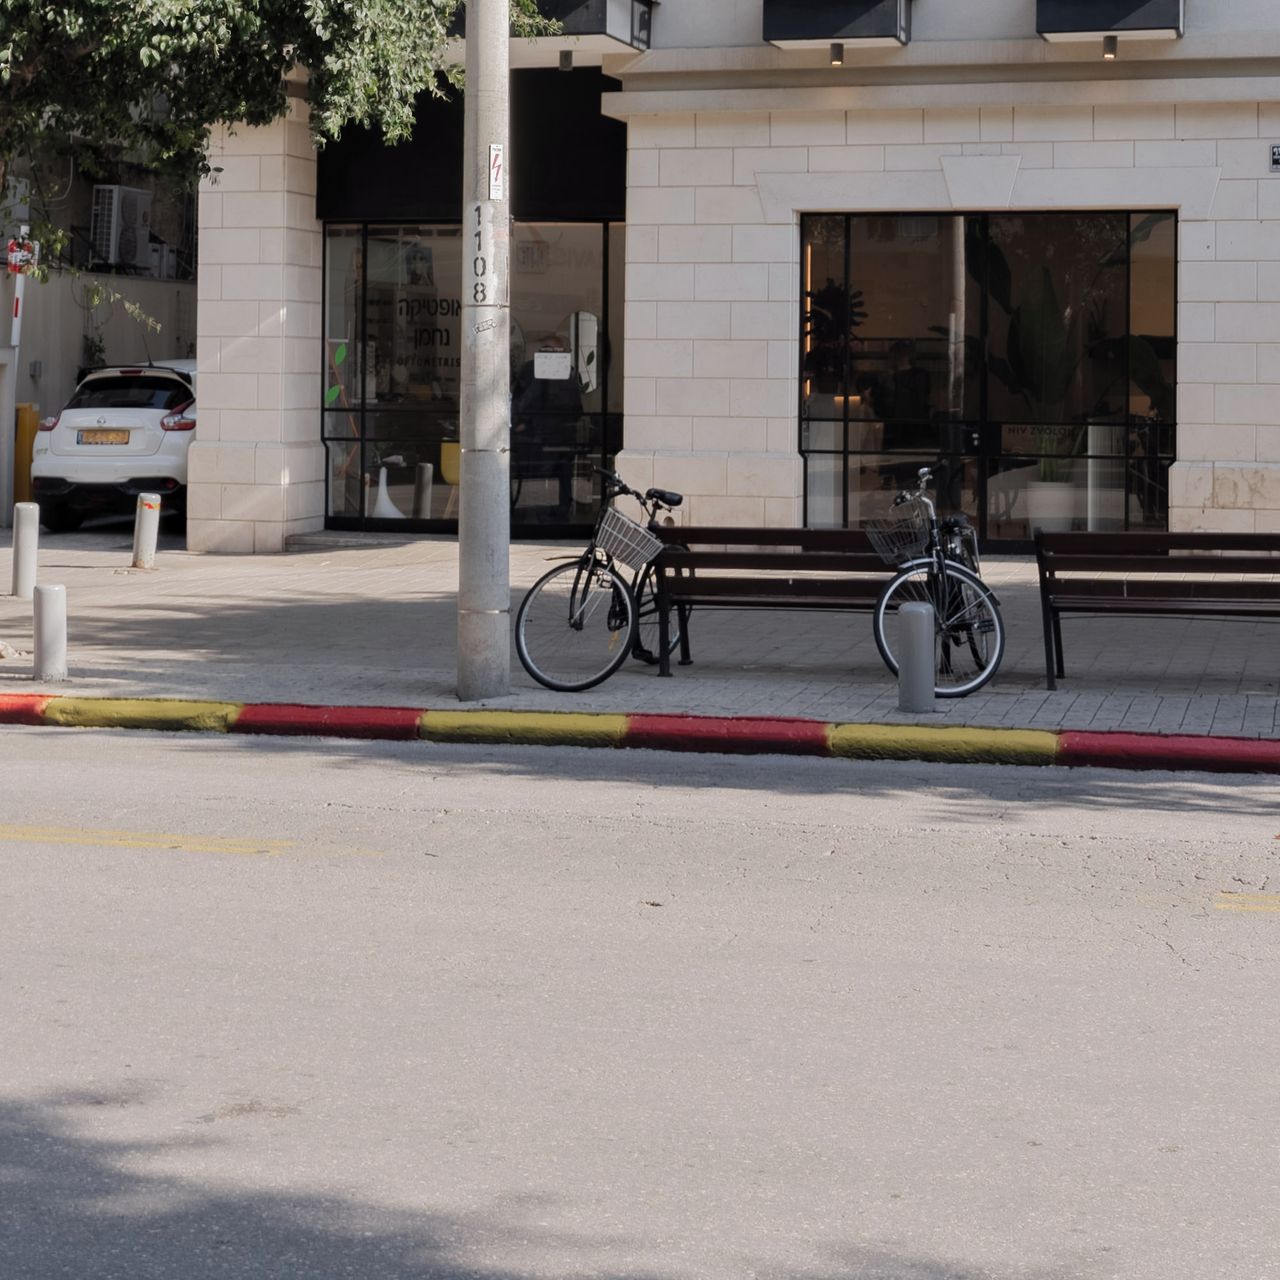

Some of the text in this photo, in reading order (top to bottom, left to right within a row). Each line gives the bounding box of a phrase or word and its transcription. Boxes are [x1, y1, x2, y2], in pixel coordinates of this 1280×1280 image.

[398, 298, 462, 320] אופטיקה
[414, 327, 450, 350] נחמן
[1007, 426, 1027, 435] NIV
